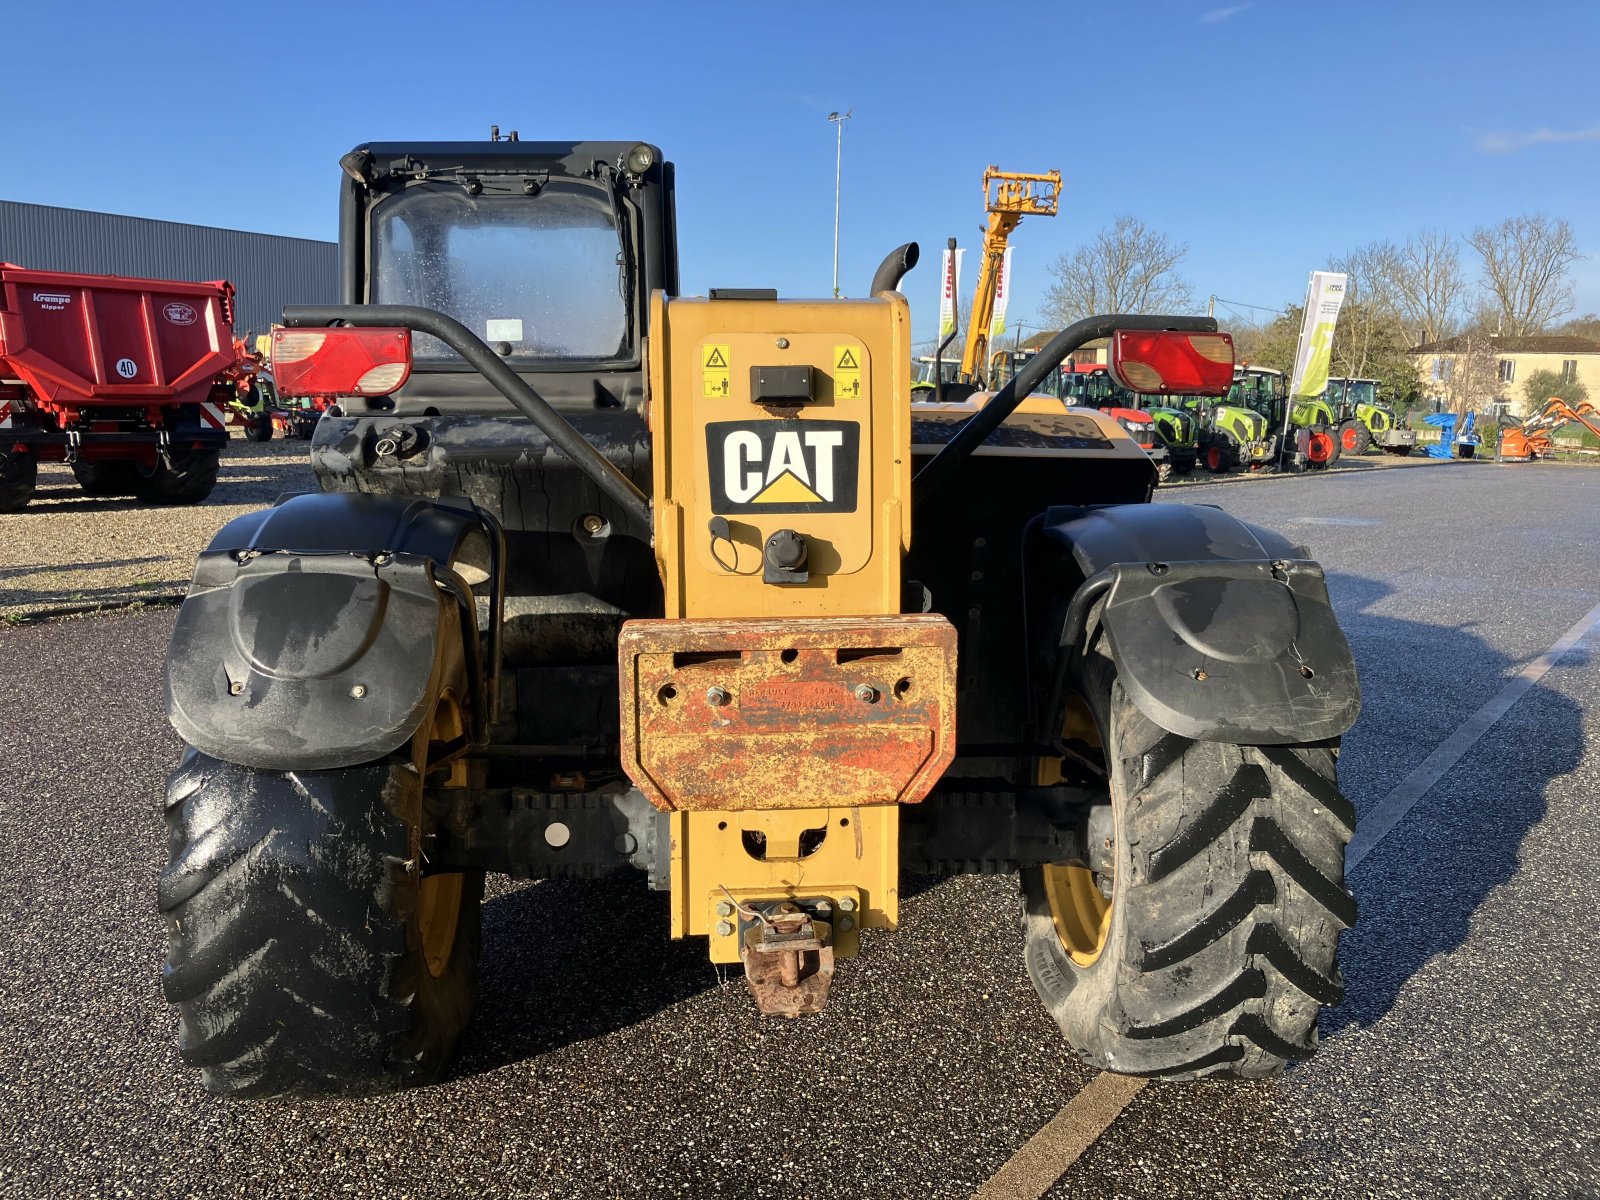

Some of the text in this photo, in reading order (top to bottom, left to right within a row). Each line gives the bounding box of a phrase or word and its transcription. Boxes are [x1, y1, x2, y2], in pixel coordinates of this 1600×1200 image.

[32, 292, 71, 305] Krampe
[121, 361, 134, 376] 40
[724, 431, 843, 504] CAT
